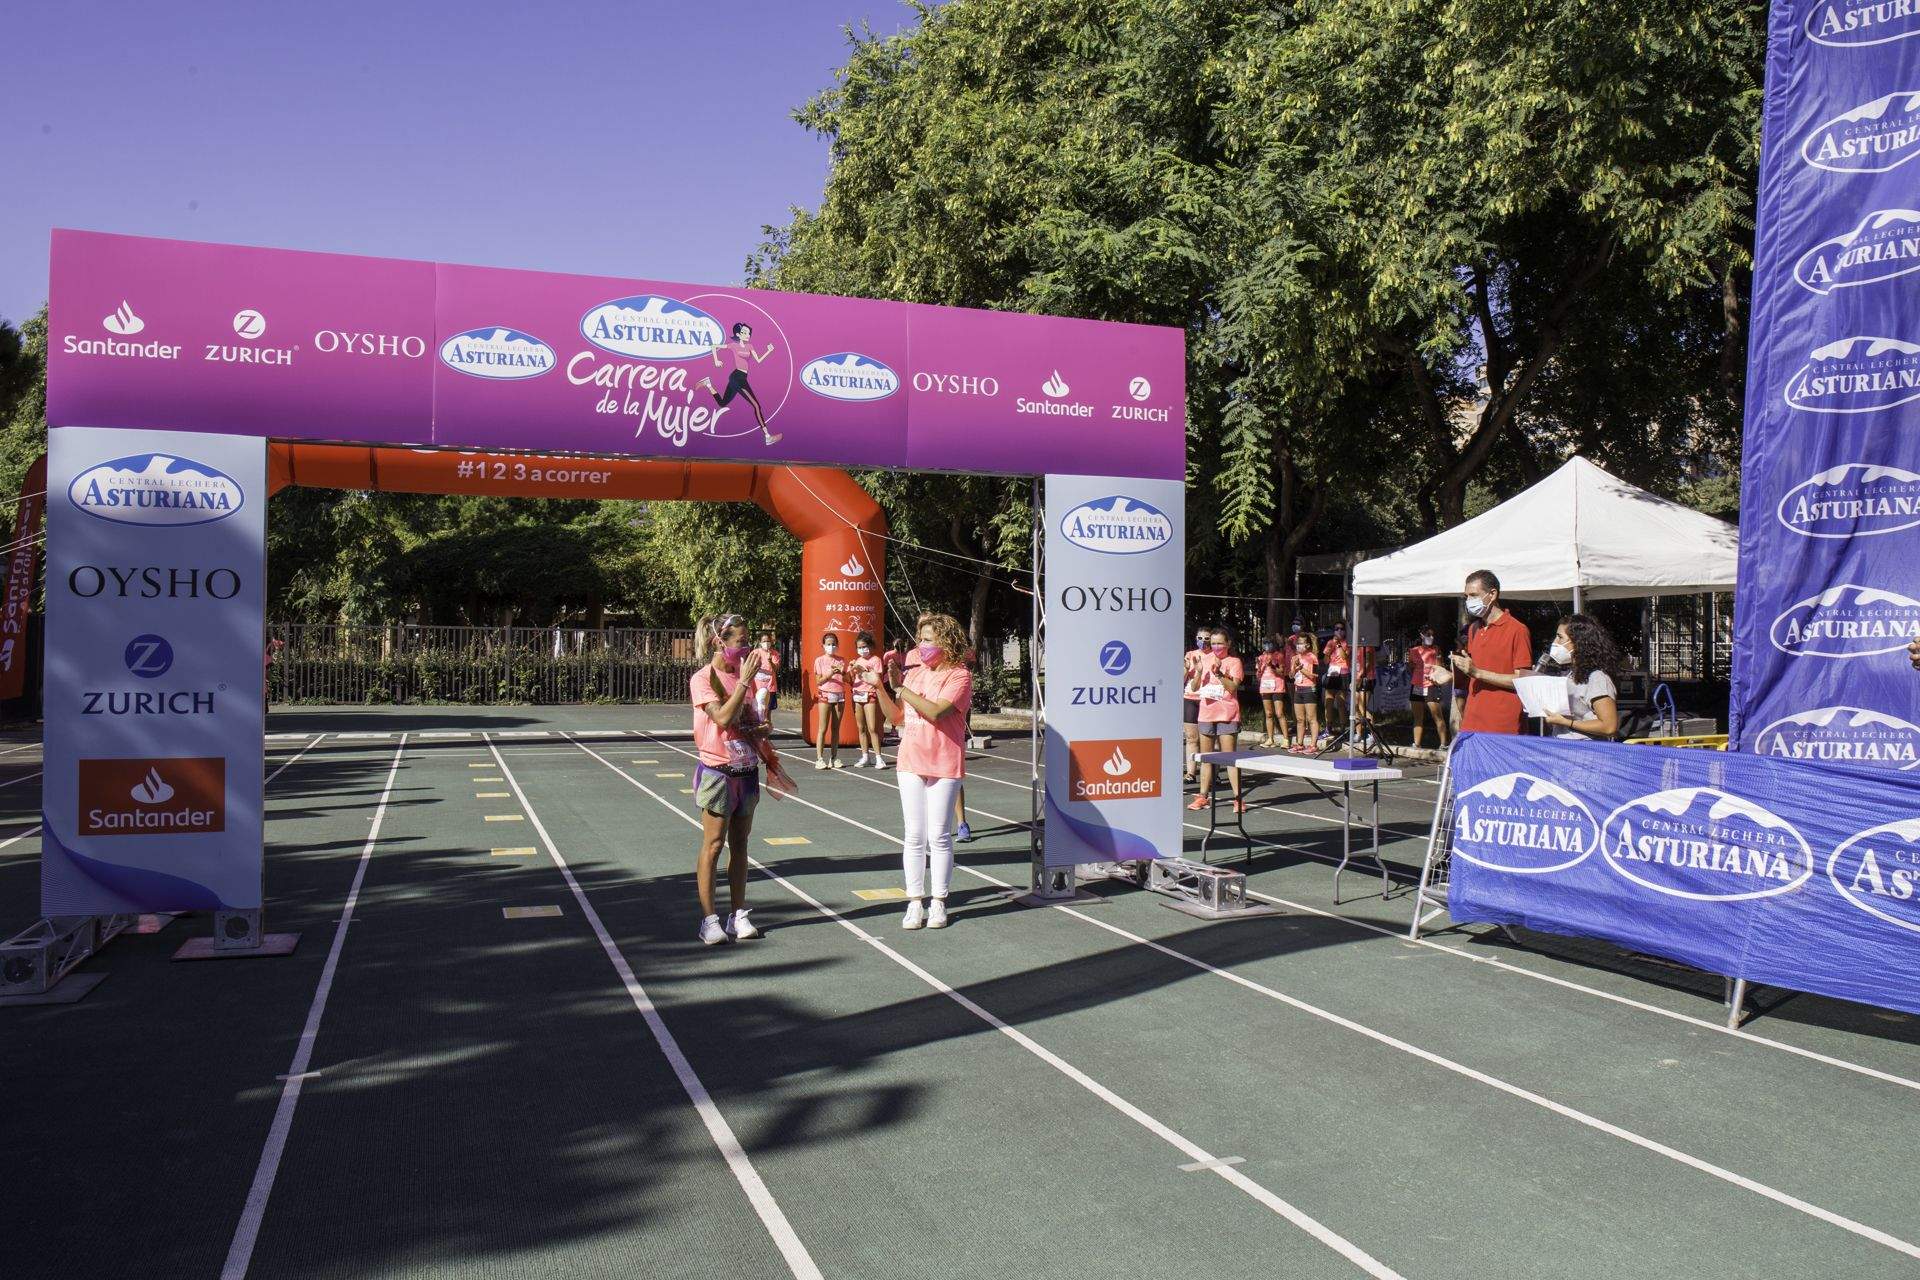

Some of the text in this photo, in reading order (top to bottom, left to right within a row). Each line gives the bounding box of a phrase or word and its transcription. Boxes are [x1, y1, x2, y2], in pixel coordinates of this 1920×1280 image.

[1845, 119, 1902, 135] CENTRAL
[592, 315, 714, 347] ASTURIANA
[614, 312, 710, 328] CENTRAL LECHERA
[63, 335, 181, 359] Santander
[204, 344, 292, 366] ZURICH
[314, 330, 425, 358] OYSHO
[449, 343, 548, 368] ASTURIANA
[567, 350, 687, 392] Carrera
[808, 367, 892, 391] ASTURIANA
[1813, 365, 1864, 374] CENTRAL
[913, 372, 999, 397] OYSHO
[596, 390, 731, 447] de la Mujer
[1016, 398, 1094, 417] Santander
[1112, 405, 1168, 422] ZURICH
[81, 478, 231, 510] ASTURIANA
[109, 477, 226, 488] CENTRAL LECHERA
[1069, 516, 1166, 541] ASTURIANA
[69, 565, 241, 600] OYSHO
[818, 578, 880, 591] Santander
[1061, 585, 1172, 612] OYSHO
[1859, 609, 1919, 617] LECHERA
[81, 692, 216, 715] ZURICH
[1071, 686, 1156, 705] ZURICH
[1770, 732, 1917, 760] ASTURIANA
[1793, 730, 1912, 739] CENTRAL LECHERA
[1076, 778, 1156, 796] Santander
[89, 808, 215, 829] Santander
[1478, 804, 1582, 822] CENTRAL LECHERA
[1454, 804, 1583, 853] ASTURIANA
[1642, 819, 1786, 846] CENTRAL LECHERA
[1612, 819, 1792, 881] ASTURIANA
